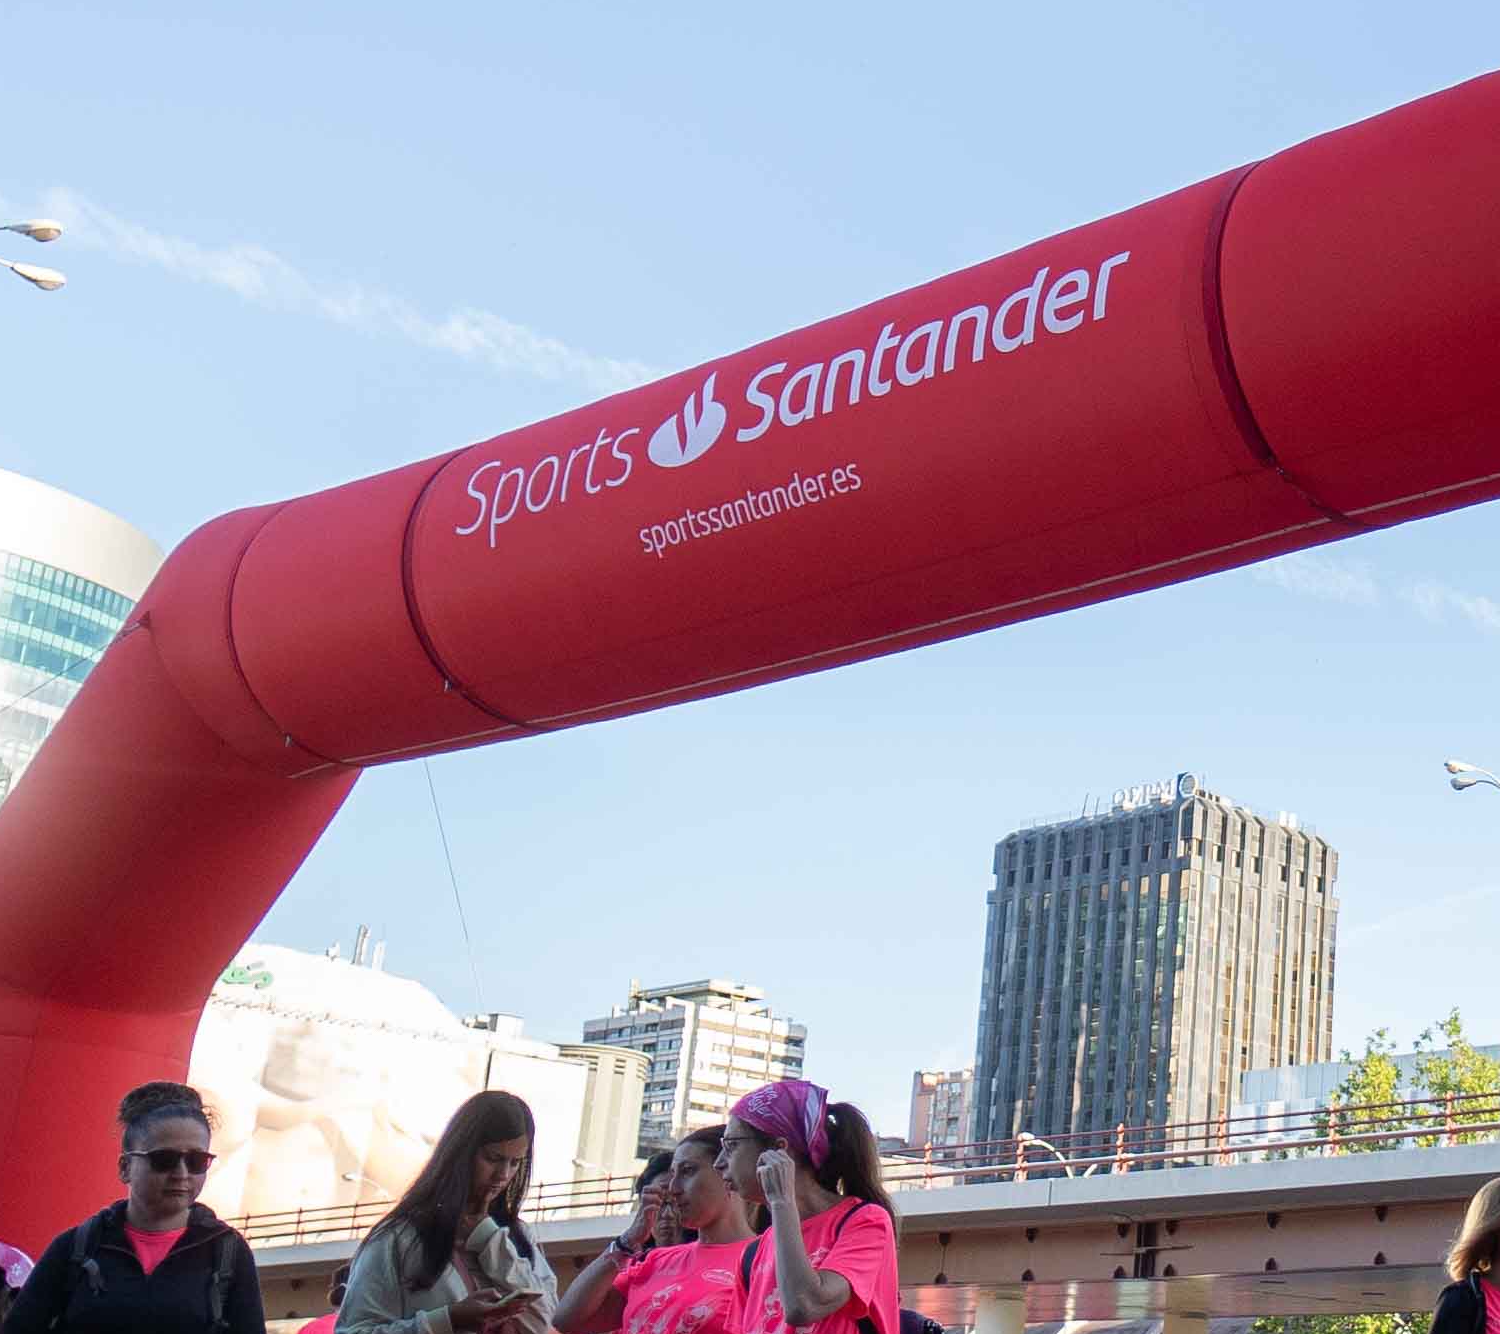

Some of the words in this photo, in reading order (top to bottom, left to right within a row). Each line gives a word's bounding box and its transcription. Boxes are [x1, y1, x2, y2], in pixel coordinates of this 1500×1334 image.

[456, 427, 640, 547] Sports
[736, 250, 1130, 442] Santander
[639, 463, 861, 557] sportssantander.es
